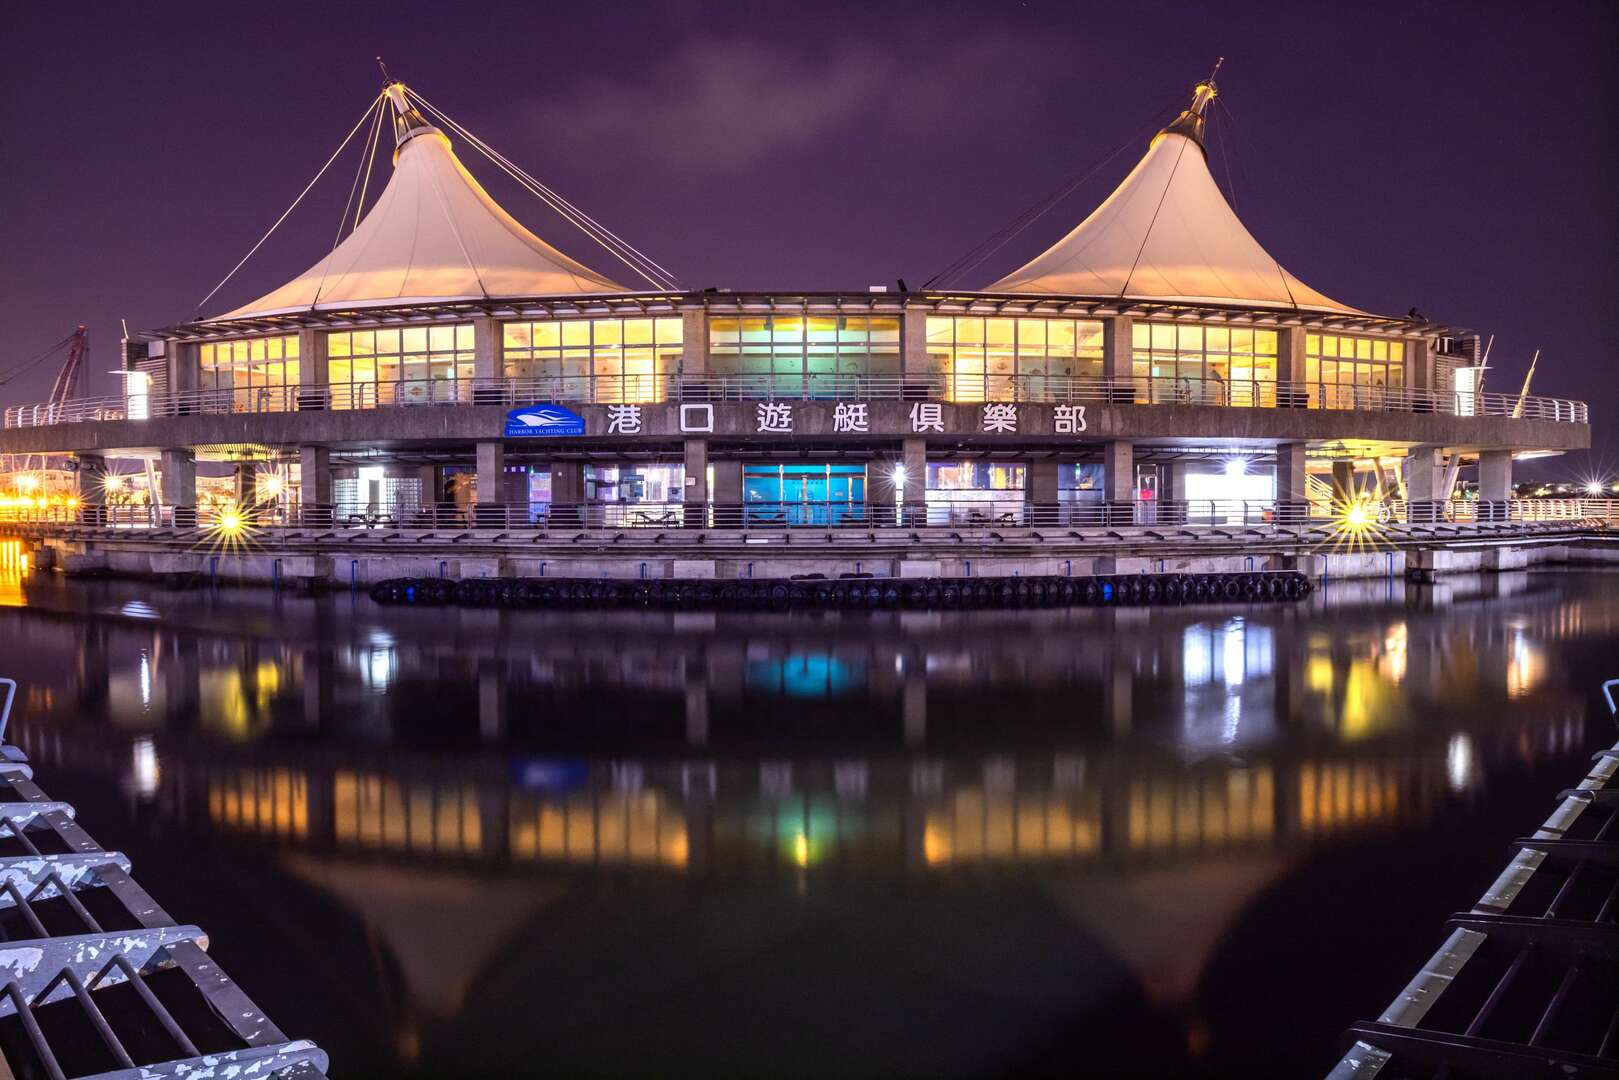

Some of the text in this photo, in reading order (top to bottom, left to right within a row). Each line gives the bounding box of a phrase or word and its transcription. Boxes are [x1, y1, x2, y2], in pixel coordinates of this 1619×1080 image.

[607, 403, 1087, 433] 港口遊艇俱樂部
